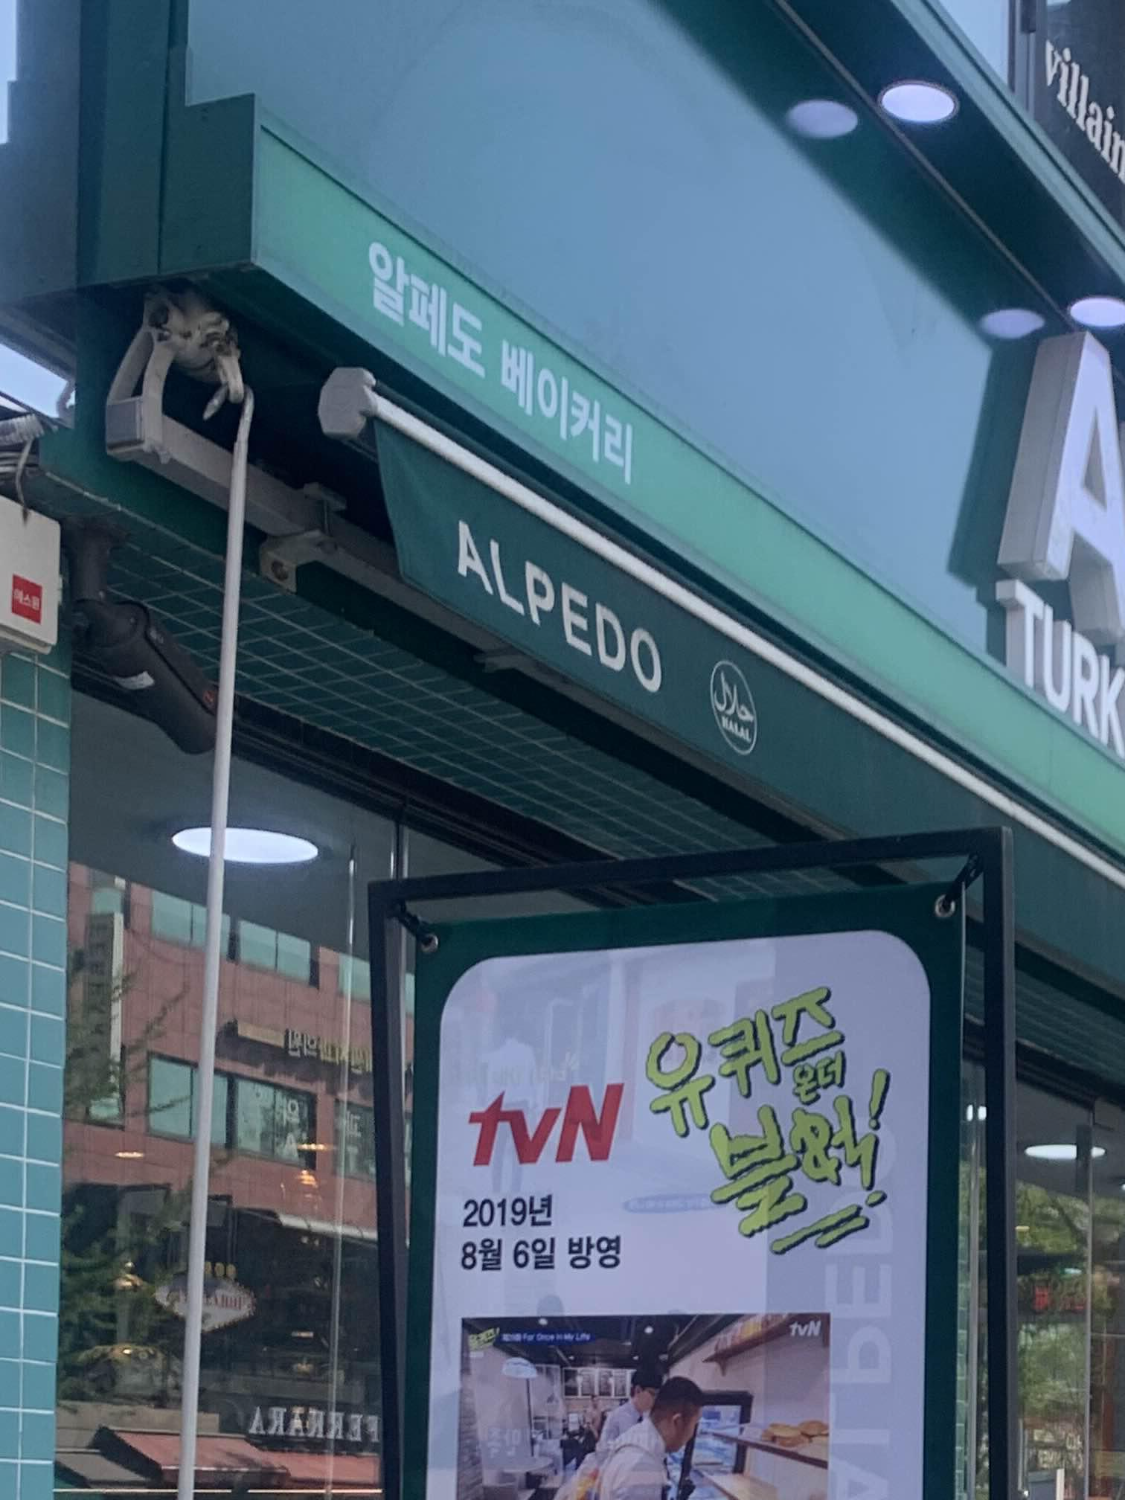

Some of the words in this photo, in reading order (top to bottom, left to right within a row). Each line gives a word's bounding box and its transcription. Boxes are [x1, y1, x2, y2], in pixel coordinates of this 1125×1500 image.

[367, 241, 486, 379] 알페도
[501, 340, 633, 485] 베이커리
[457, 520, 662, 693] ALPEDO
[721, 715, 752, 743] HALAL
[468, 1083, 625, 1167] tvN
[462, 1194, 553, 1228] 2019년
[460, 1238, 503, 1272] 8월
[512, 1236, 557, 1270] 6일
[567, 1234, 622, 1270] 방영
[789, 1321, 822, 1337] tvN
